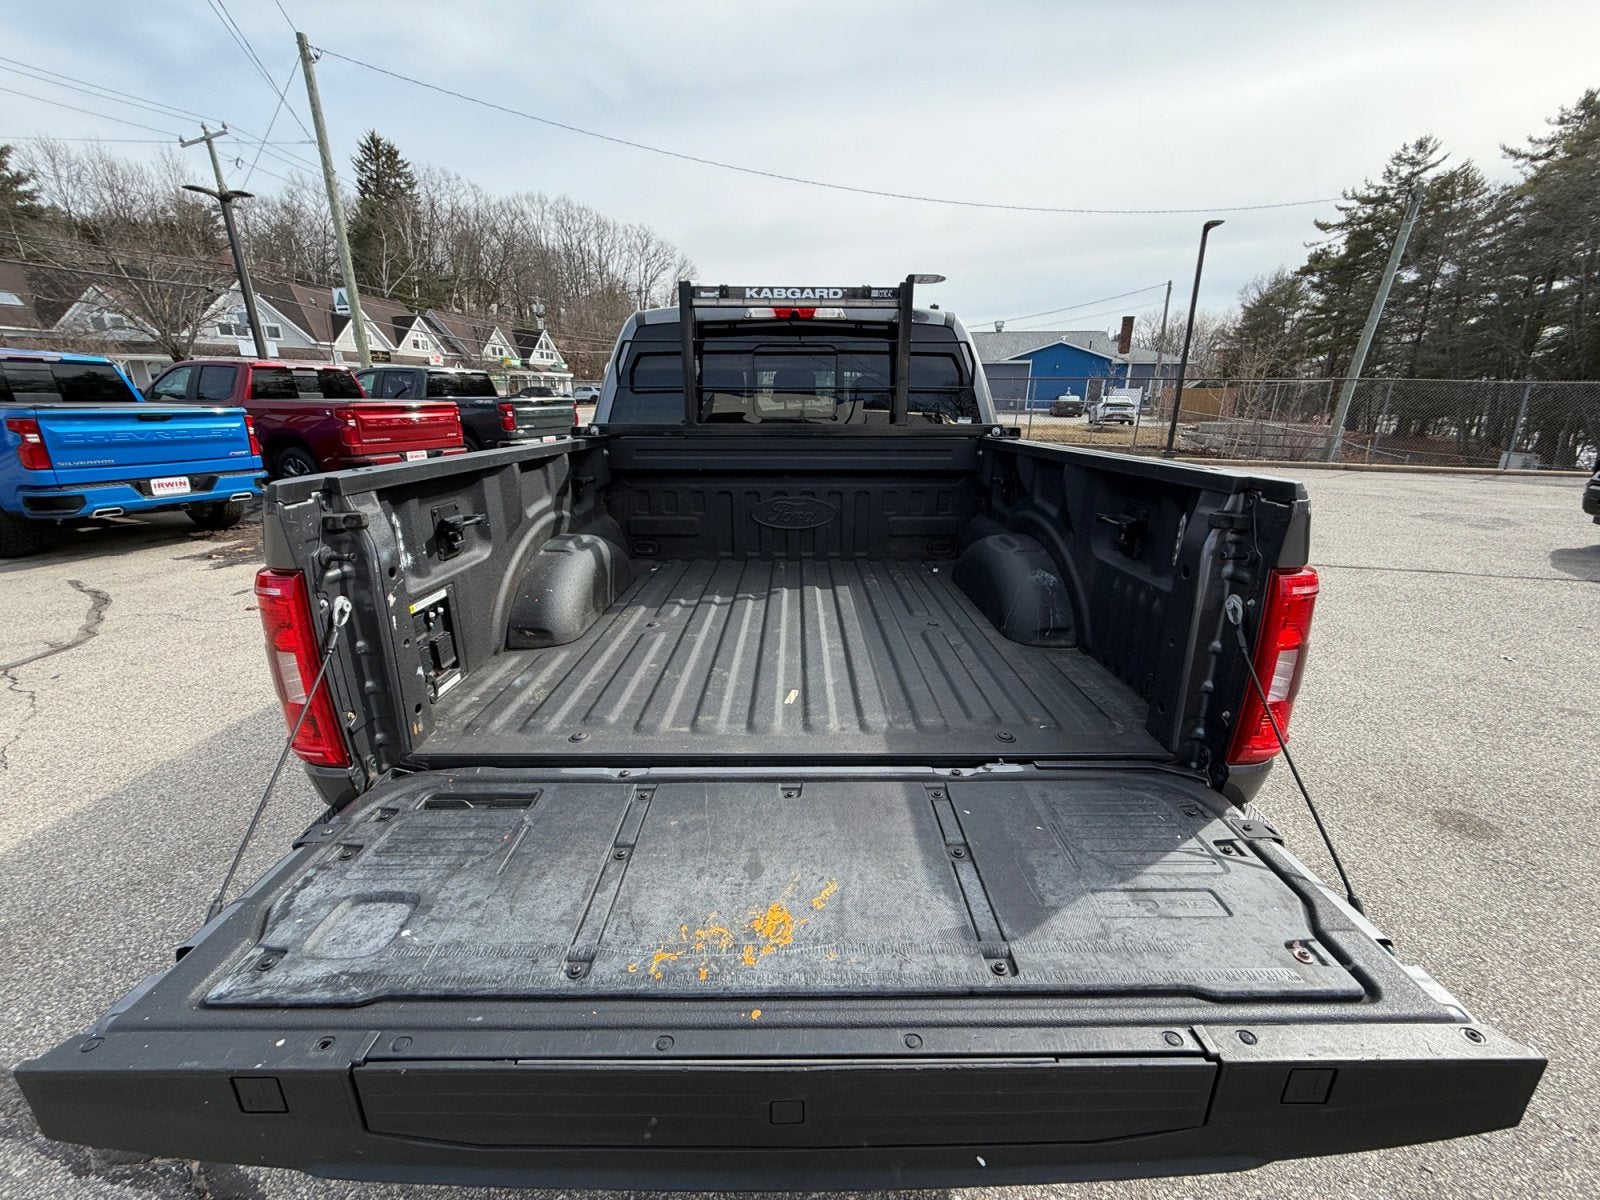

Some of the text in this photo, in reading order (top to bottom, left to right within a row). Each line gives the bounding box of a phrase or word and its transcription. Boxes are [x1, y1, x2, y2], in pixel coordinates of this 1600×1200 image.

[745, 287, 843, 299] KABGARD
[63, 428, 238, 443] CHEVROLET
[153, 480, 187, 489] IRWIN
[767, 501, 820, 522] Ford
